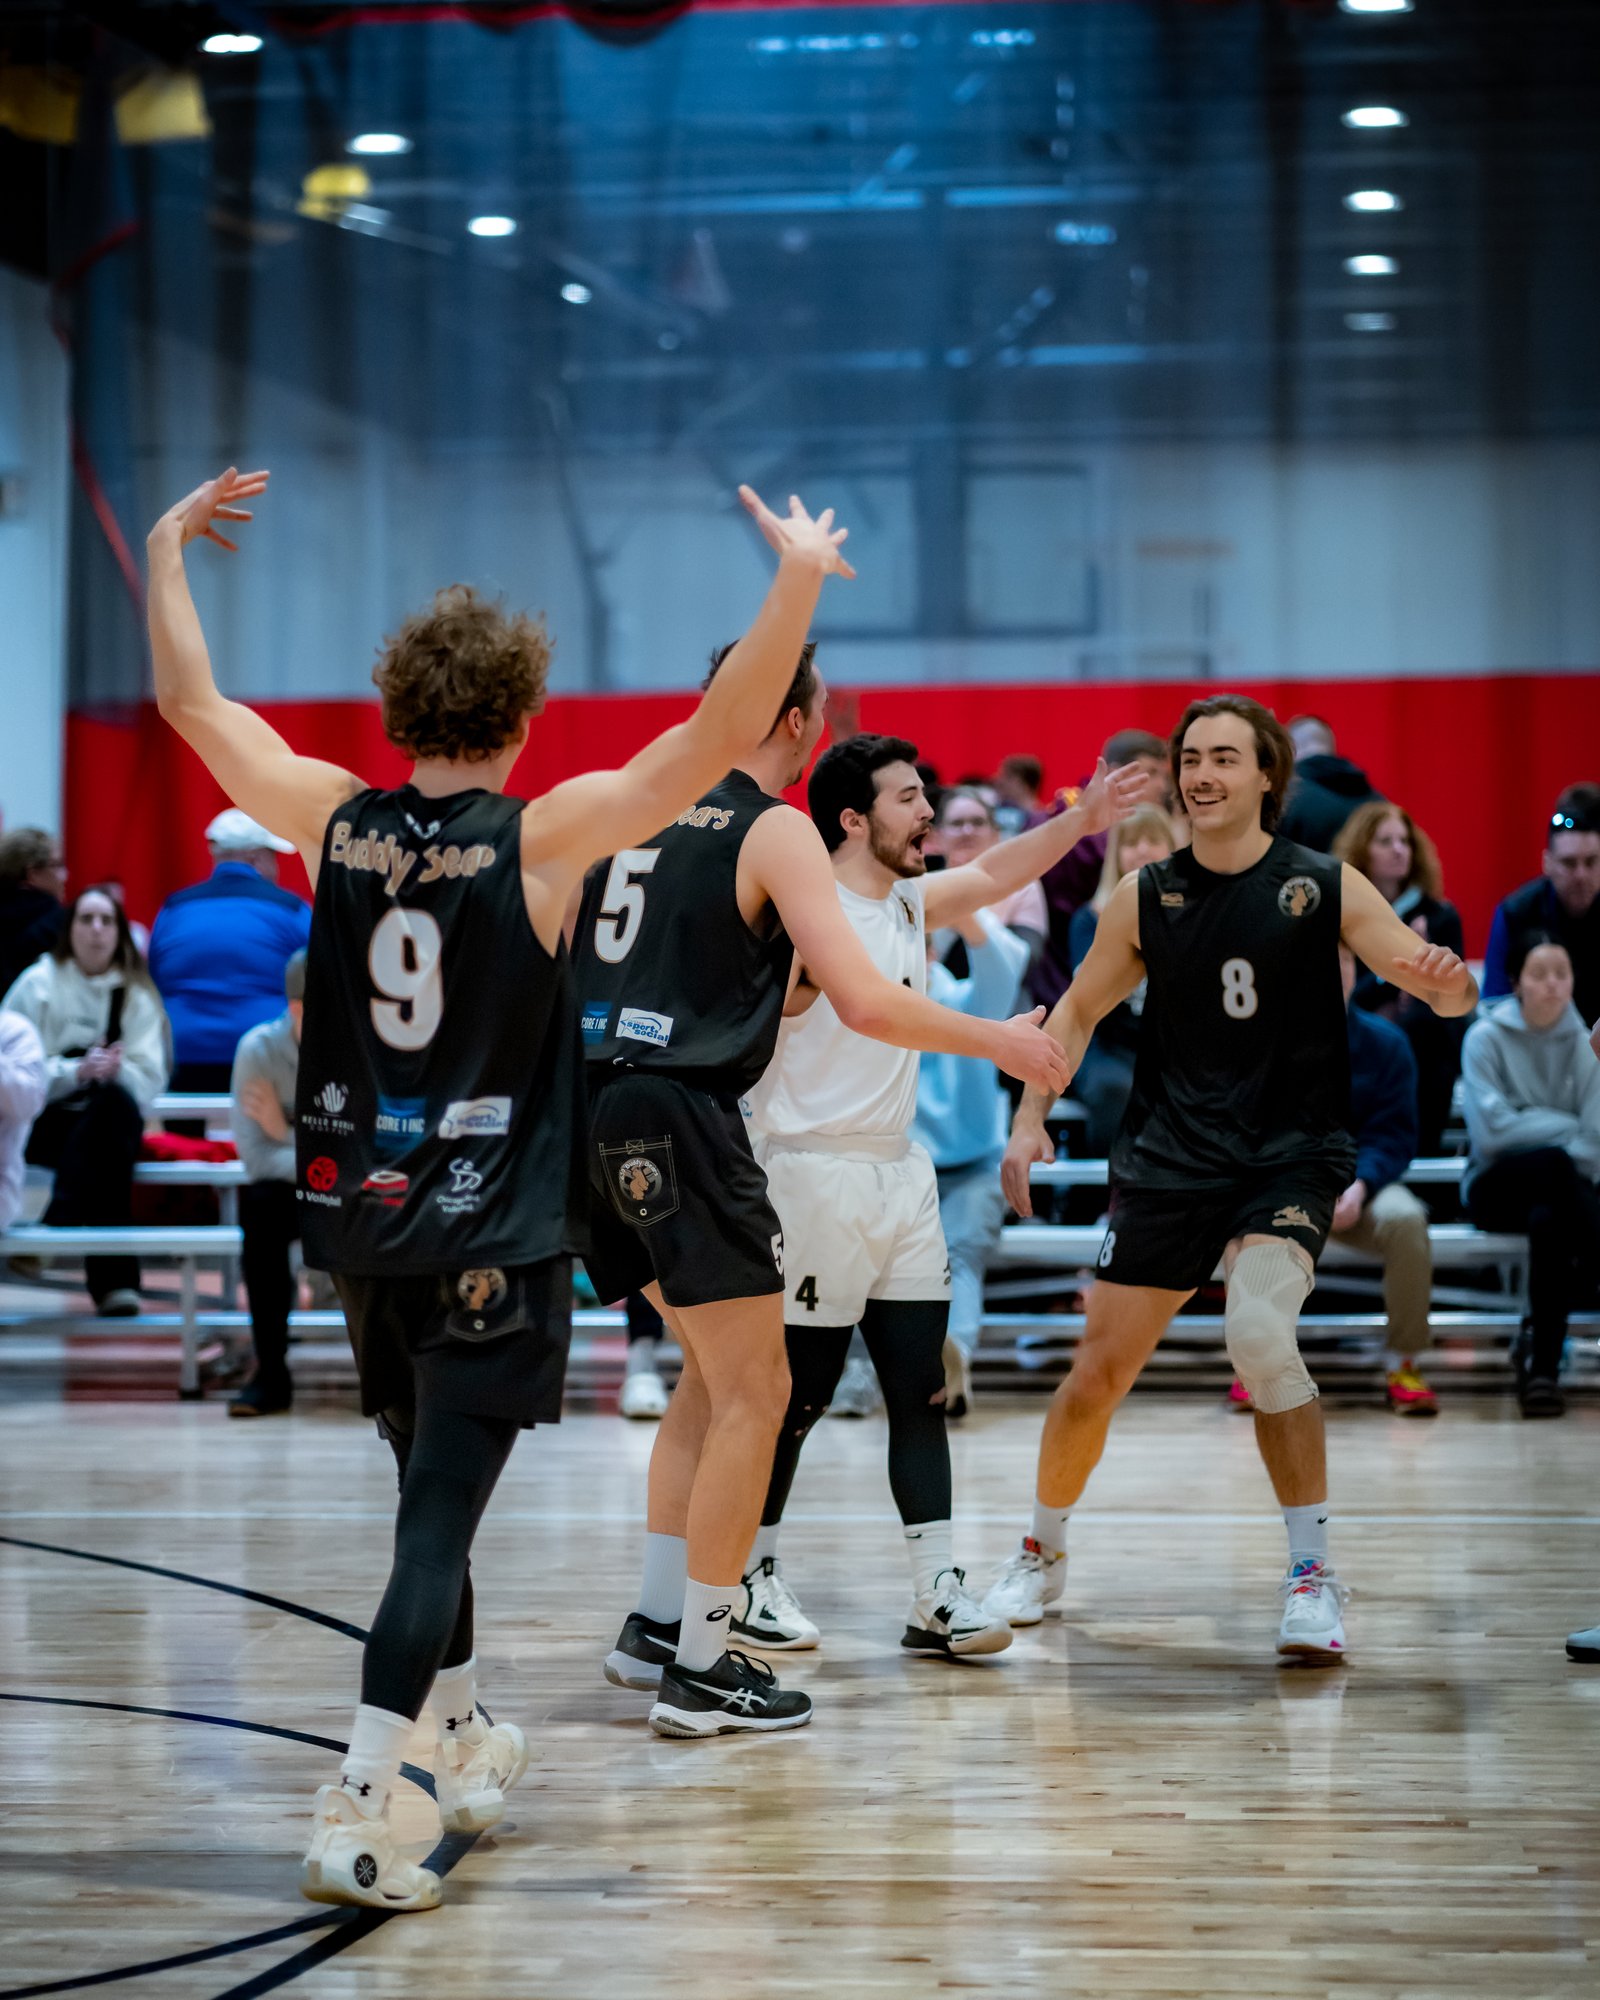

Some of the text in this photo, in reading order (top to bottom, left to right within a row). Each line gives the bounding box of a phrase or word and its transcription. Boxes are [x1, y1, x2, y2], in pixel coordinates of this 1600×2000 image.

[667, 805, 735, 831] ears
[330, 821, 417, 897] Buddy
[594, 848, 662, 964] 5
[368, 907, 445, 1052] 9
[1221, 957, 1258, 1019] 8
[634, 1029, 669, 1042] social
[376, 1115, 400, 1132] CORE
[408, 1118, 425, 1133] INC
[770, 1232, 784, 1277] 5
[1099, 1230, 1117, 1268] 8
[795, 1274, 819, 1312] 4
